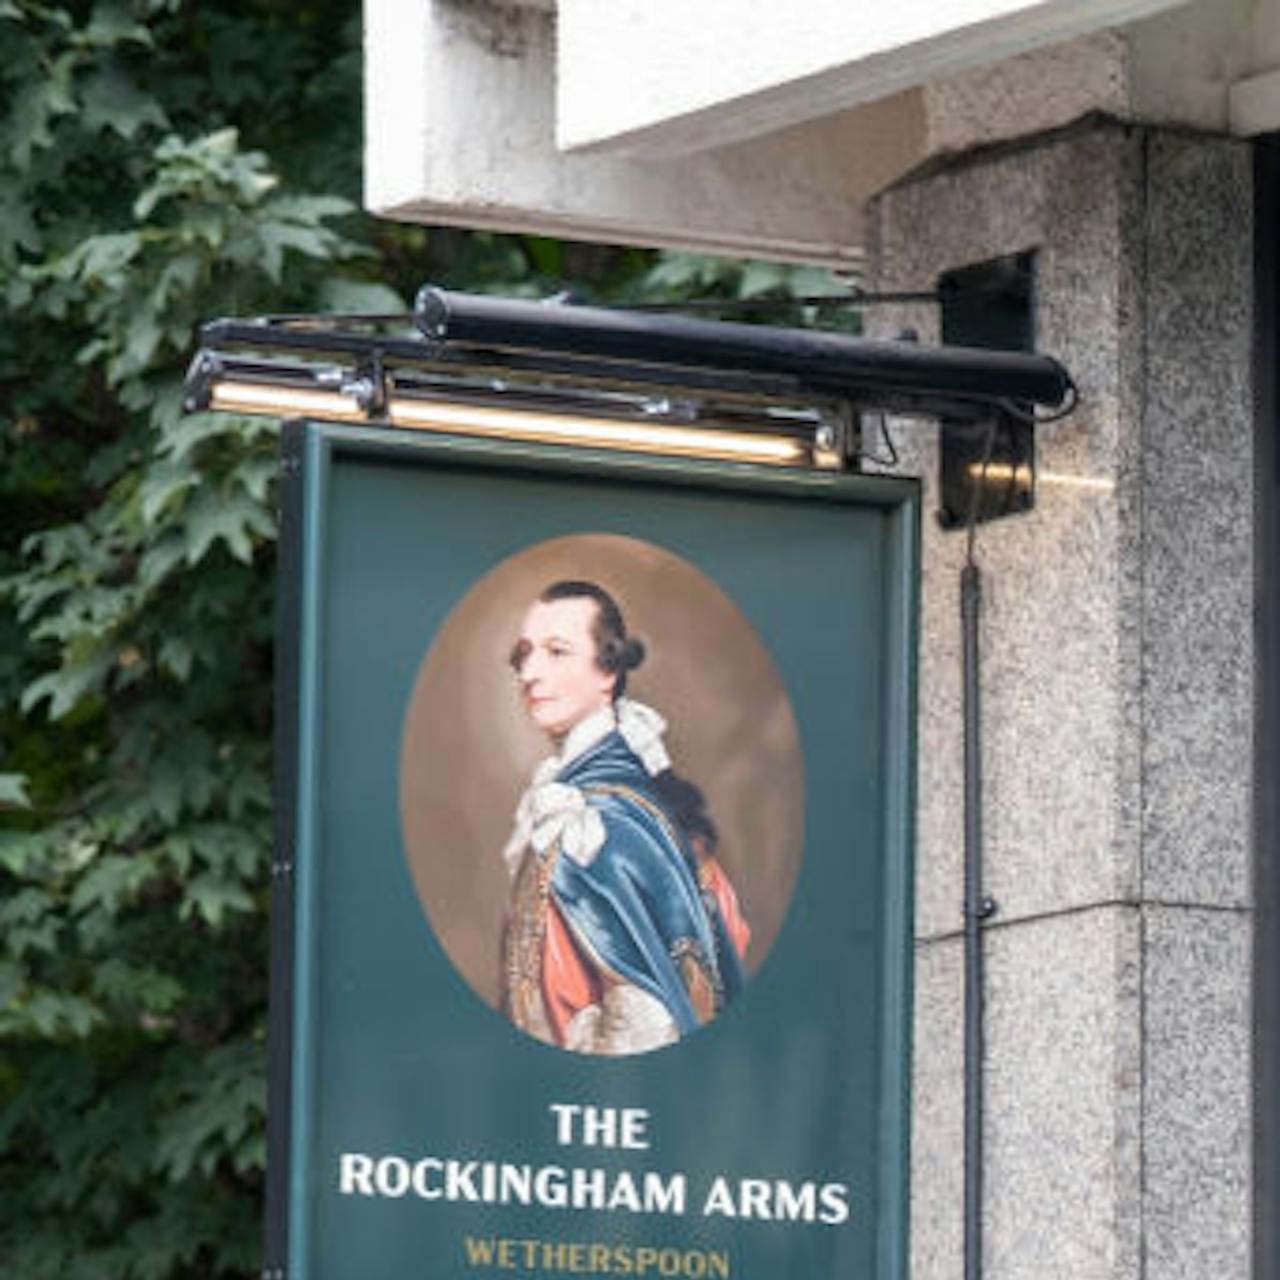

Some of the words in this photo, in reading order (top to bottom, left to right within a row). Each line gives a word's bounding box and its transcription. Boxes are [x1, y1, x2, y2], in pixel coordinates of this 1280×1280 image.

[550, 1103, 651, 1149] THE
[339, 1153, 687, 1215] ROCKINGHAM
[703, 1177, 850, 1225] ARMS
[466, 1237, 730, 1280] WETHERSPOON
